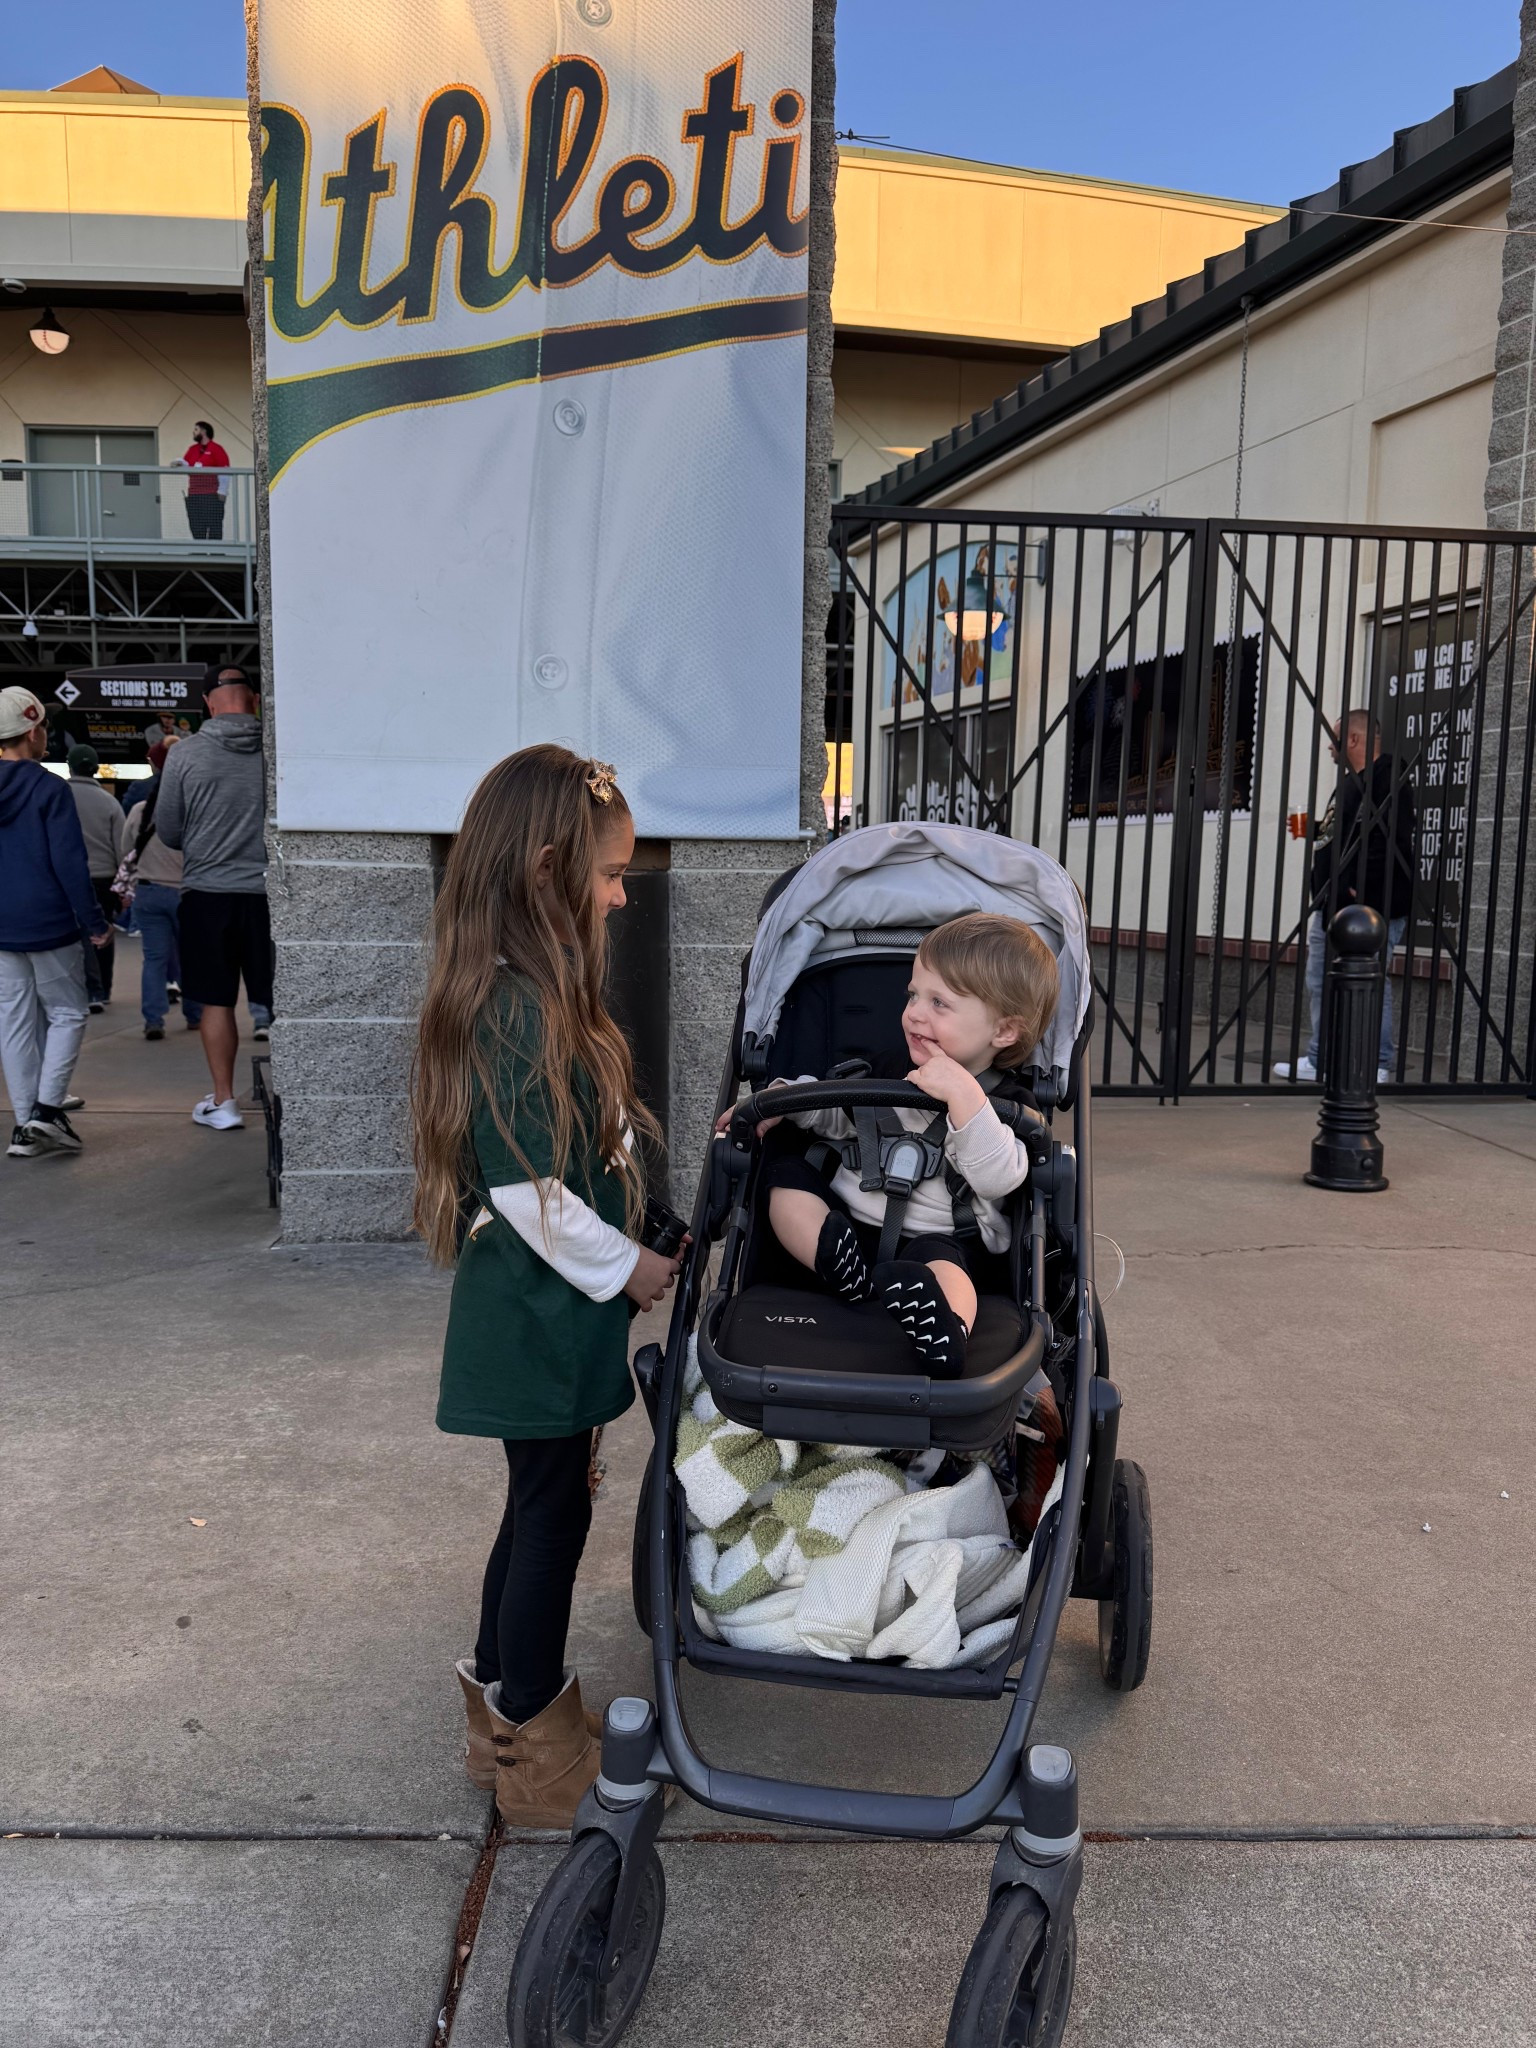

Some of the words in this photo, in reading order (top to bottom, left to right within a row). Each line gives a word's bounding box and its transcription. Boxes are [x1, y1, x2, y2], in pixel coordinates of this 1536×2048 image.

[100, 680, 148, 697] SECTIONS
[149, 681, 188, 698] 112-125
[765, 1316, 817, 1324] VISTA
